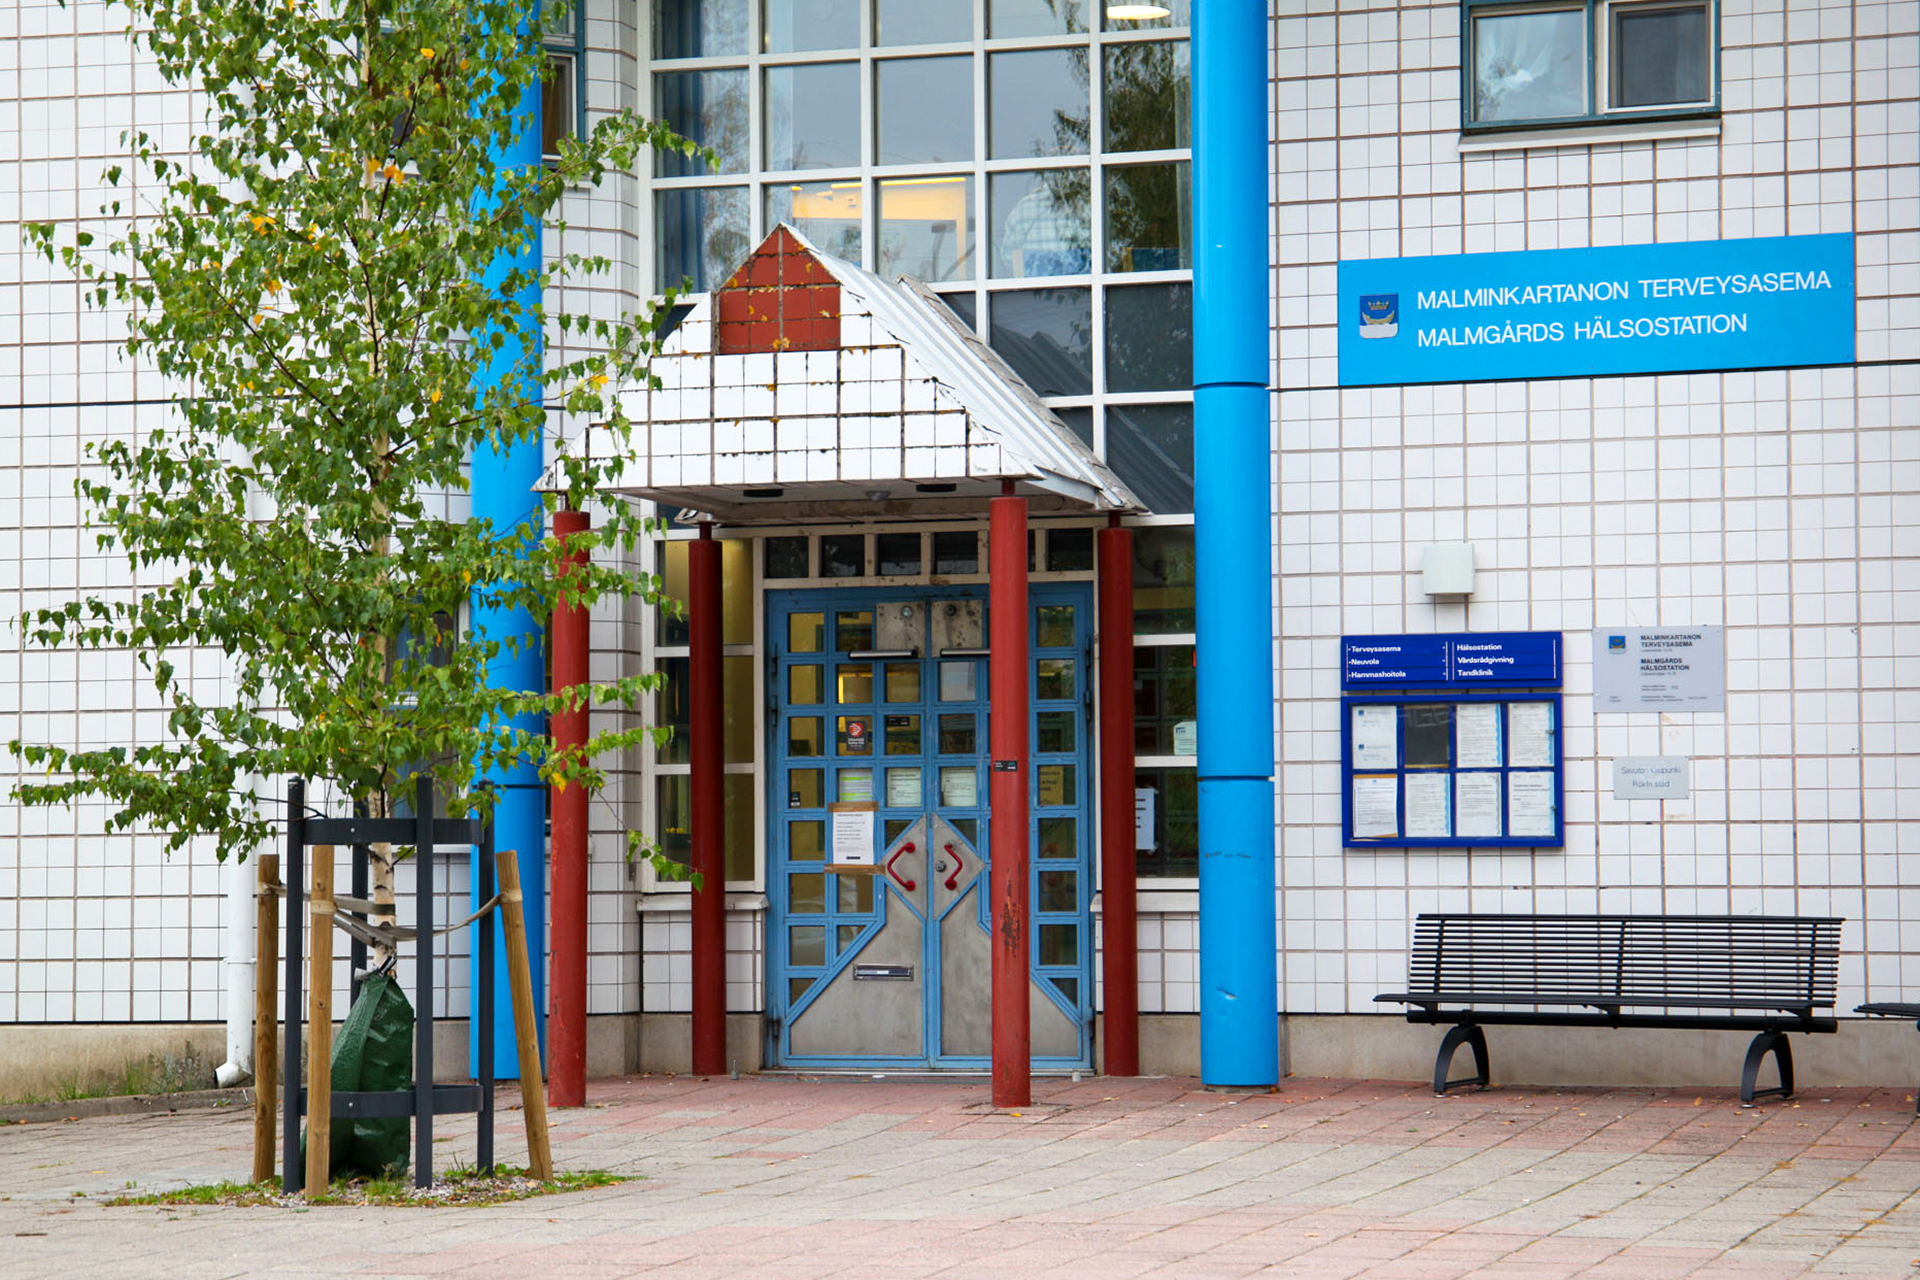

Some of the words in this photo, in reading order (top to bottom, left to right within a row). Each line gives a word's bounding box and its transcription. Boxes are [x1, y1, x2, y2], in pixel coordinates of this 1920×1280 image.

[1418, 280, 1629, 310] MALMINKARTANON
[1637, 270, 1832, 299] TERVEYSASEMA
[1418, 320, 1565, 348] MALMGÅRDS
[1574, 314, 1747, 341] HÄLSOSTATION
[1350, 645, 1402, 654] Terveysasema
[1456, 643, 1503, 651] Hälsostation
[1350, 658, 1380, 666] Neuvola
[1351, 670, 1407, 678] Hammashoitola
[1457, 669, 1494, 677] Tandklinik
